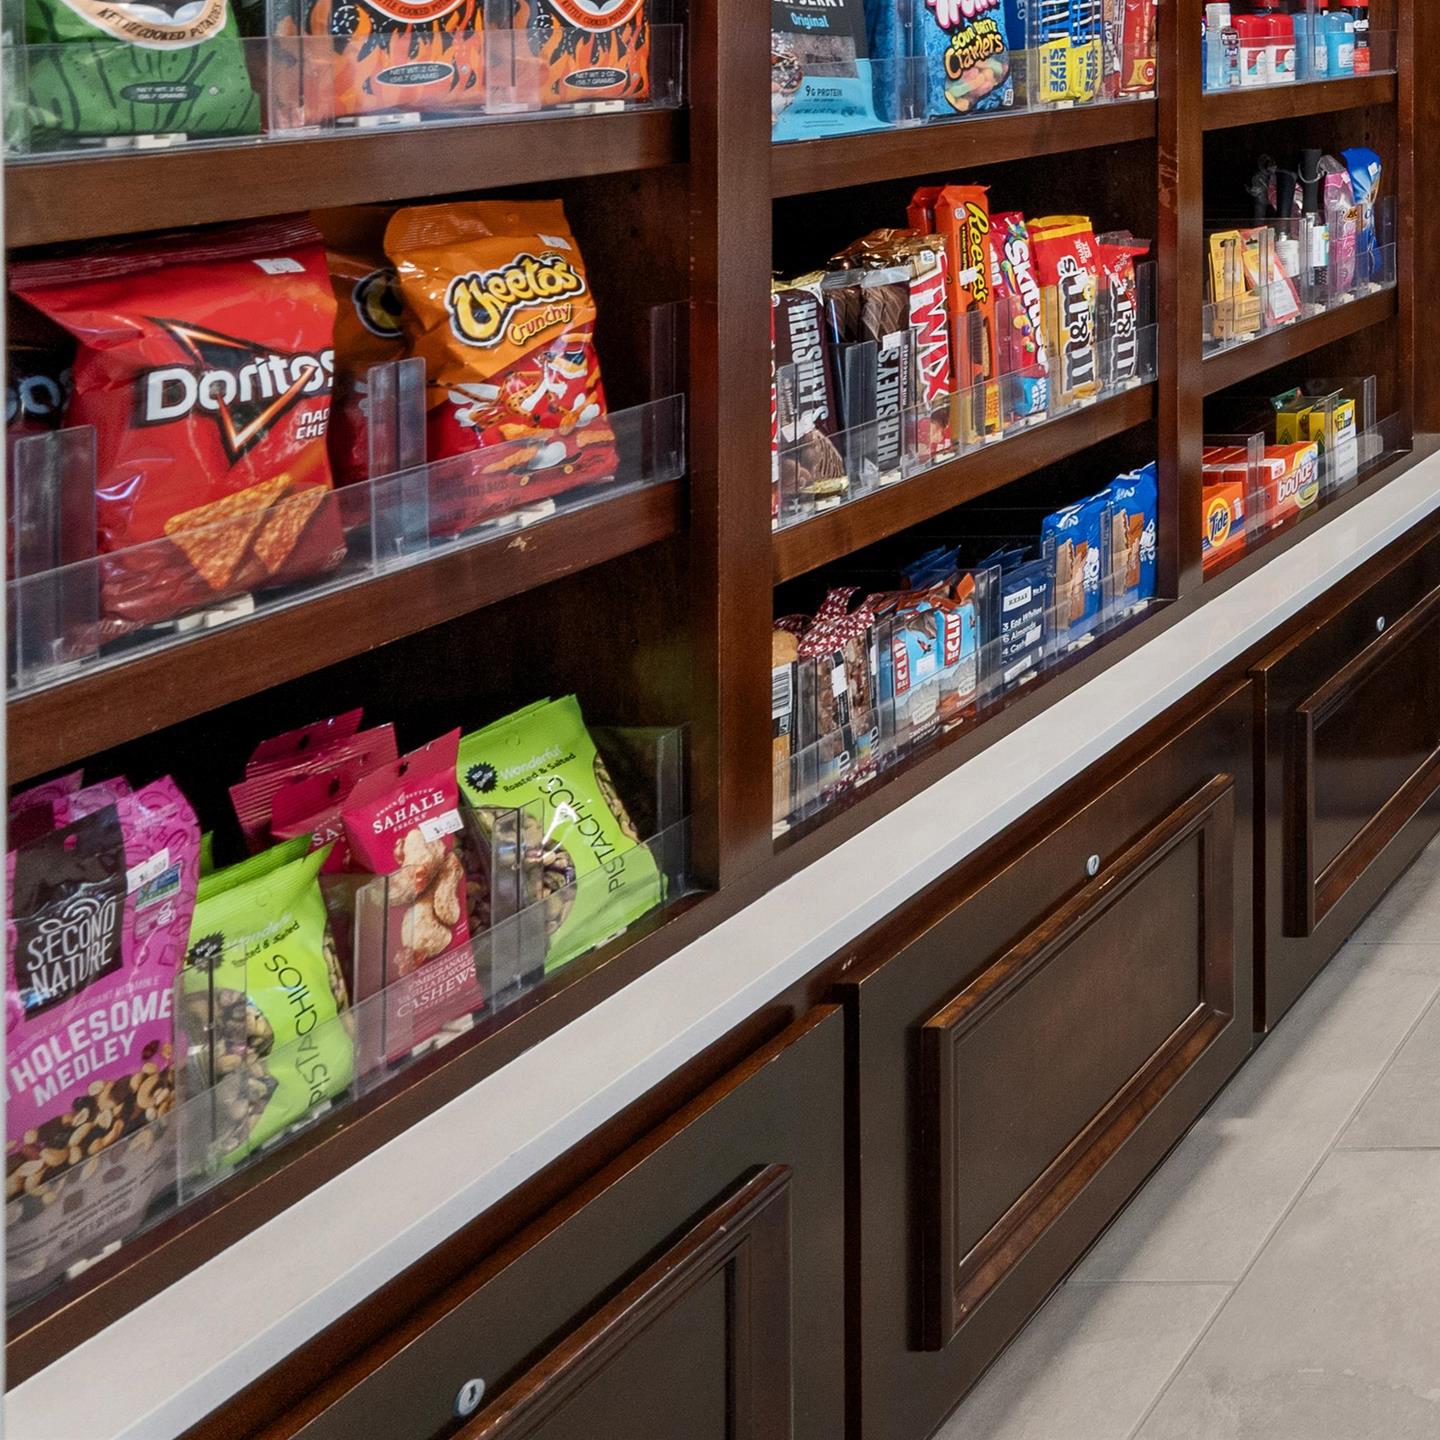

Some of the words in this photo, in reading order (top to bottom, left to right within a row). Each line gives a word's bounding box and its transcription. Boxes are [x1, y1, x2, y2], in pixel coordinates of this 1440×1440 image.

[399, 6, 430, 16] COOKED
[561, 0, 582, 22] KETTLE
[583, 16, 607, 25] COOKED
[791, 11, 830, 30] Original
[137, 28, 186, 41] COOKED
[945, 33, 1005, 80] Crawlers
[952, 27, 976, 49] SOUR
[1050, 48, 1058, 92] SIZE
[1058, 47, 1067, 92] KING
[817, 88, 844, 97] PROTEIN
[964, 201, 989, 304] Reese's
[451, 254, 582, 342] Cheetos
[507, 302, 573, 347] Crunchy
[908, 252, 951, 403] TWIX
[786, 301, 829, 422] HERSHEY'S
[145, 349, 335, 424] Doritos
[876, 346, 900, 466] HERSHEY'S
[1277, 462, 1315, 505] bounce
[1208, 509, 1229, 540] Tide
[1002, 622, 1009, 632] 3
[1011, 623, 1037, 641] Almonds
[500, 744, 563, 780] Wonderful
[503, 771, 538, 793] Roasted
[538, 765, 548, 775] &
[547, 752, 576, 771] Salted
[372, 790, 445, 835] SAHALE
[393, 811, 428, 833] SNACKS
[538, 777, 627, 893] PISTACHIOS
[26, 897, 118, 973] SECOND
[30, 933, 114, 1000] NATURE
[396, 963, 477, 1018] CASHEWS
[6, 987, 176, 1100] HOLESOME
[264, 953, 330, 1109] PISTACHIOS
[33, 1030, 137, 1109] MEDLEY
